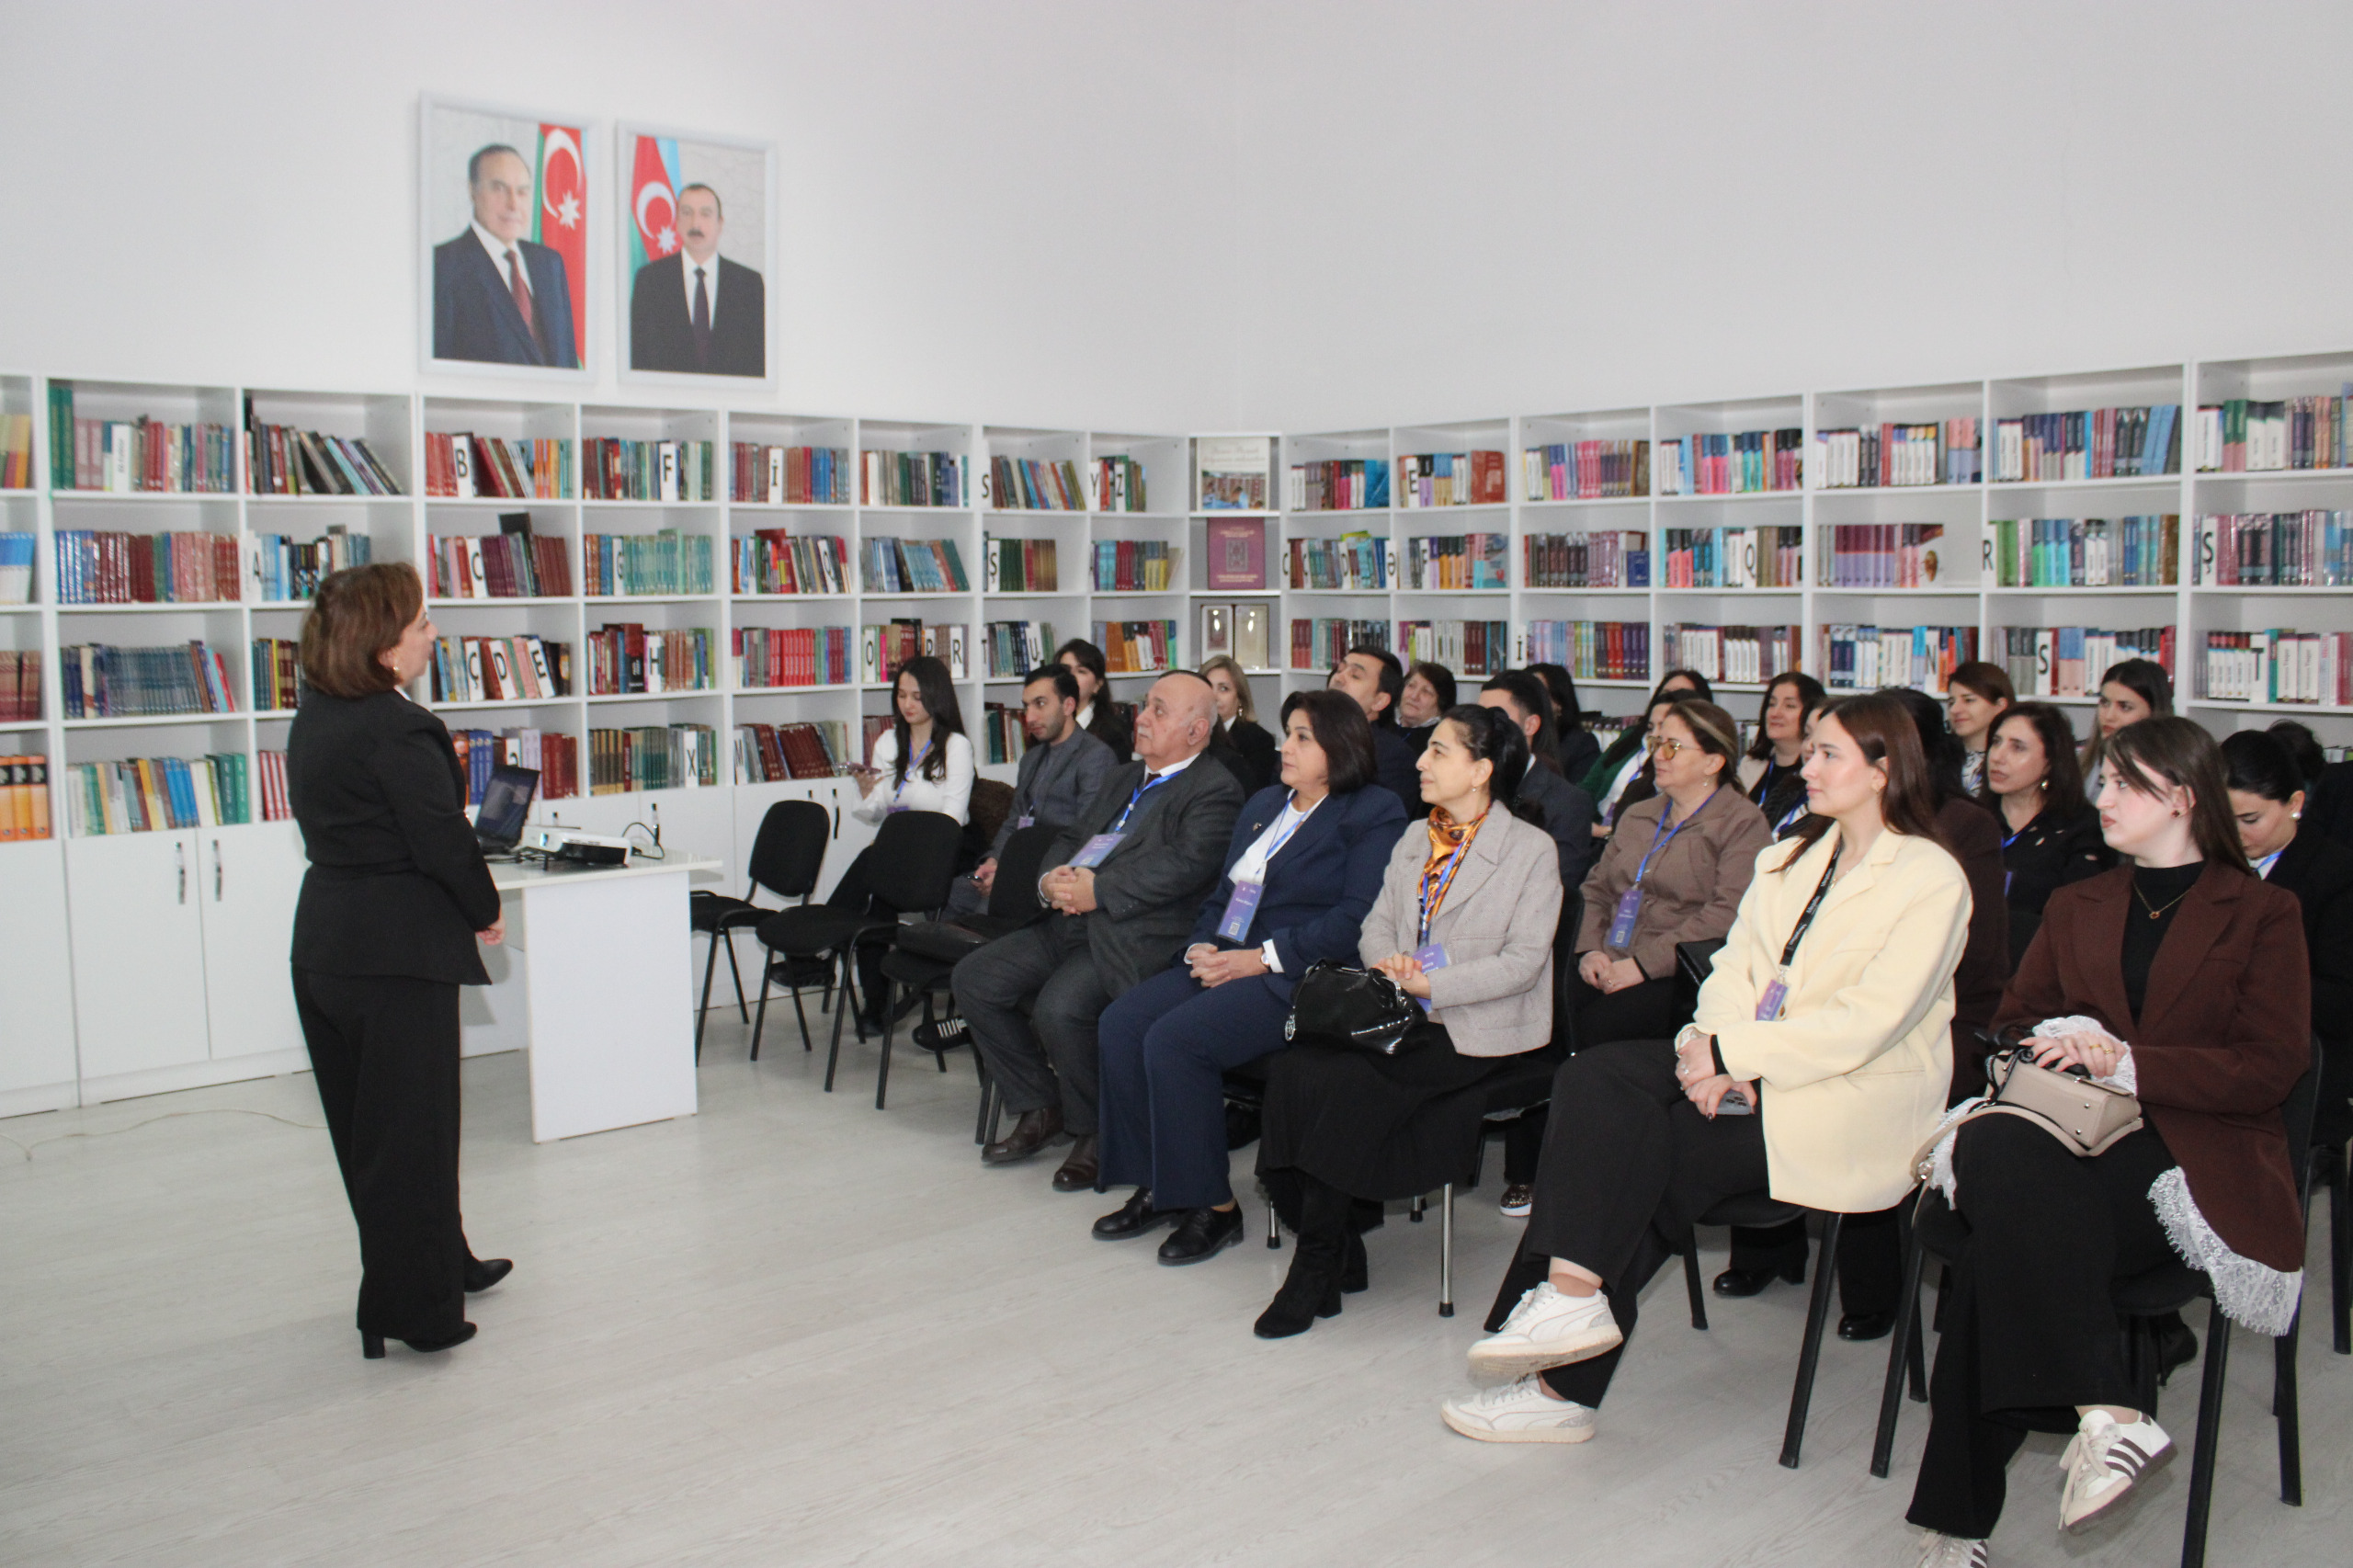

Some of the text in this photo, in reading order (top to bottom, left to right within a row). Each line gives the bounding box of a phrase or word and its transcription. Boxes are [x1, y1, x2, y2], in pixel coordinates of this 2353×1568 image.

[455, 448, 468, 478] B
[663, 454, 673, 483] F
[981, 473, 990, 499] S
[1089, 472, 1099, 498] Y
[1116, 473, 1123, 498] Z
[1409, 470, 1417, 495] E
[471, 551, 483, 581] C
[1745, 543, 1756, 580] Q
[1983, 540, 1993, 571] R
[2201, 531, 2213, 574] Ş
[530, 649, 546, 679] E
[649, 646, 661, 676] H
[953, 638, 963, 665] R
[981, 638, 988, 665] T
[1029, 637, 1040, 663] U
[1926, 643, 1936, 676] N
[2038, 644, 2048, 676] S
[2251, 647, 2264, 682] T
[468, 651, 480, 689] Ç
[493, 651, 507, 681] D
[686, 748, 698, 778] X
